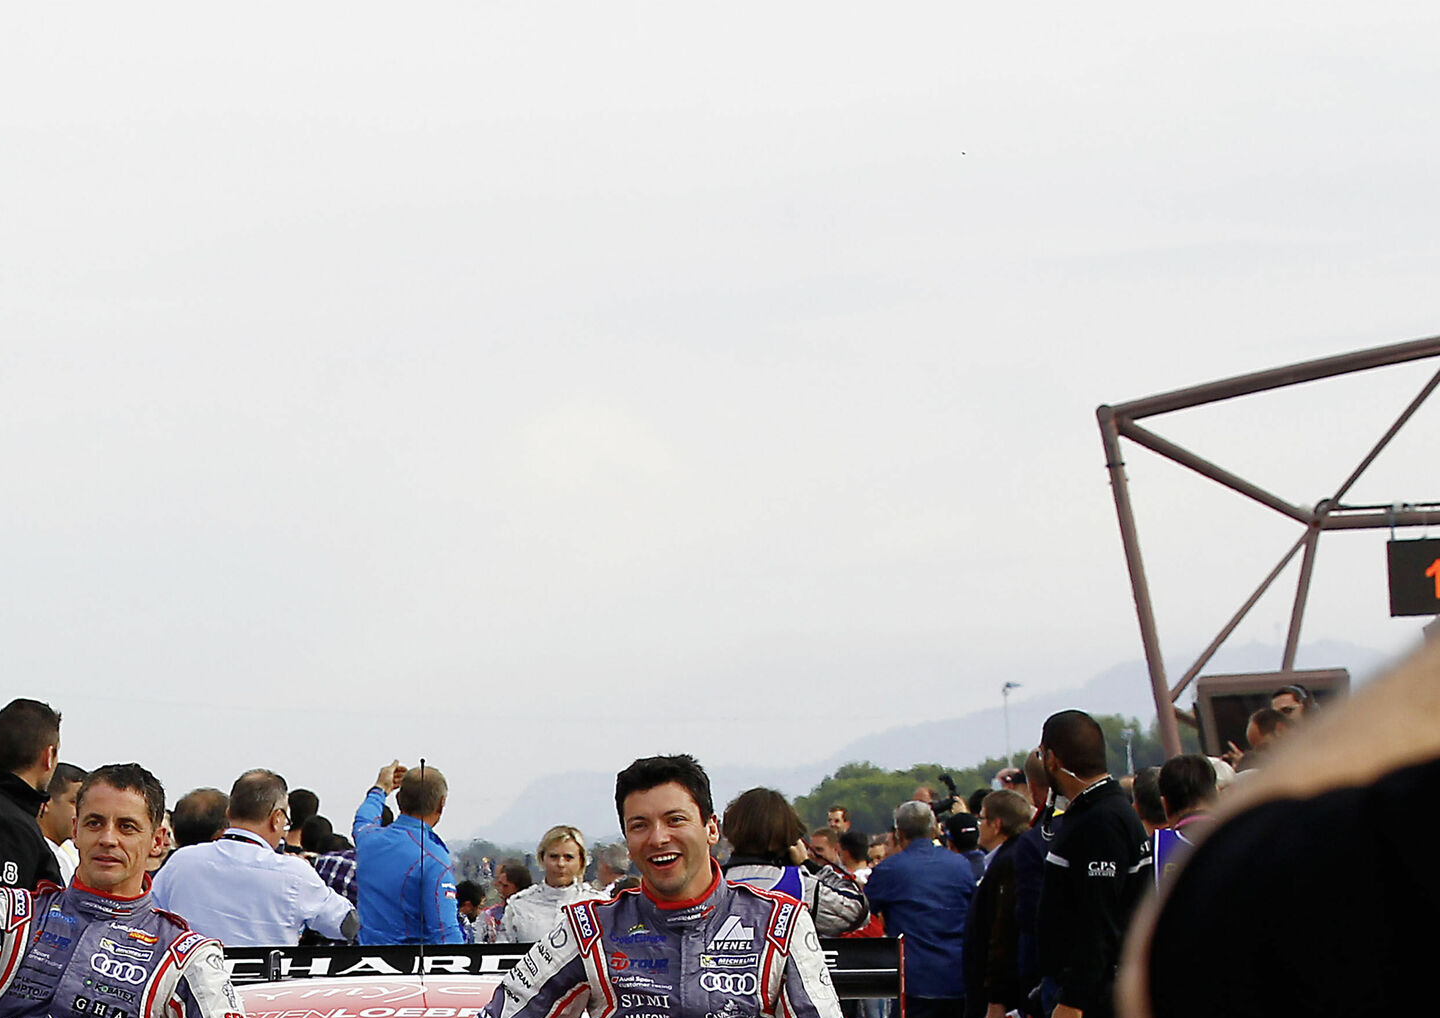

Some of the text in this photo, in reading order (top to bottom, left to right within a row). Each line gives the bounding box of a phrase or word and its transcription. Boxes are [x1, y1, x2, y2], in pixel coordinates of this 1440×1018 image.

[574, 905, 592, 937] sparco
[773, 903, 794, 938] sparco
[707, 941, 752, 950] AVENEL
[718, 957, 755, 965] MICHELIN
[621, 994, 671, 1009] STMI
